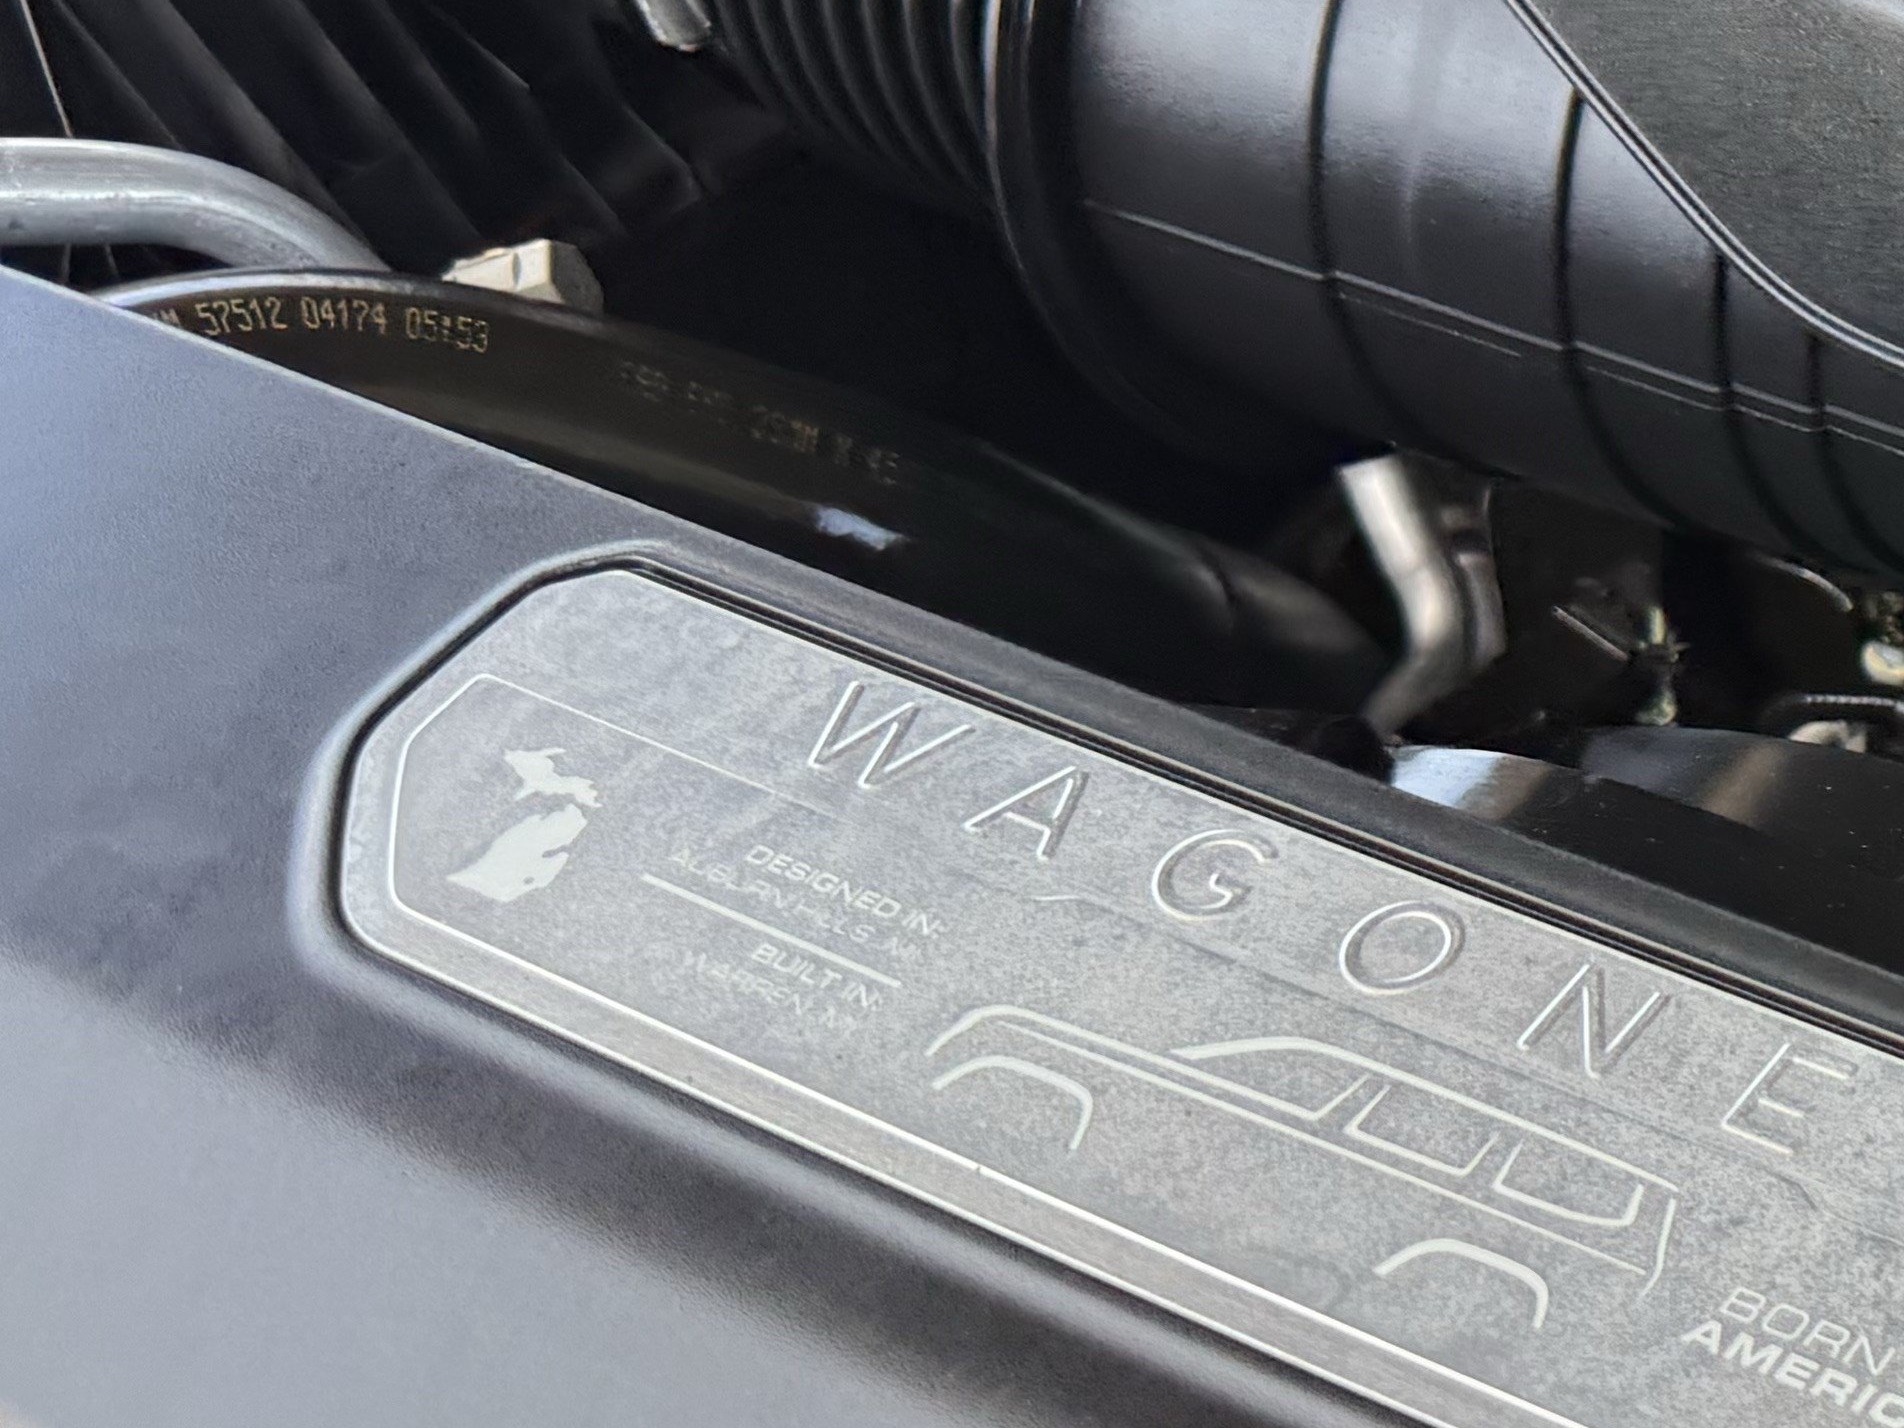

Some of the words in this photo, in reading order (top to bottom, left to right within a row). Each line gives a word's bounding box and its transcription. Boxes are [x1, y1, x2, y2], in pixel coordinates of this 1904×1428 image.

[744, 844, 902, 919] DESIGNED
[750, 940, 844, 990] BUILT
[1719, 1285, 1897, 1376] BORN
